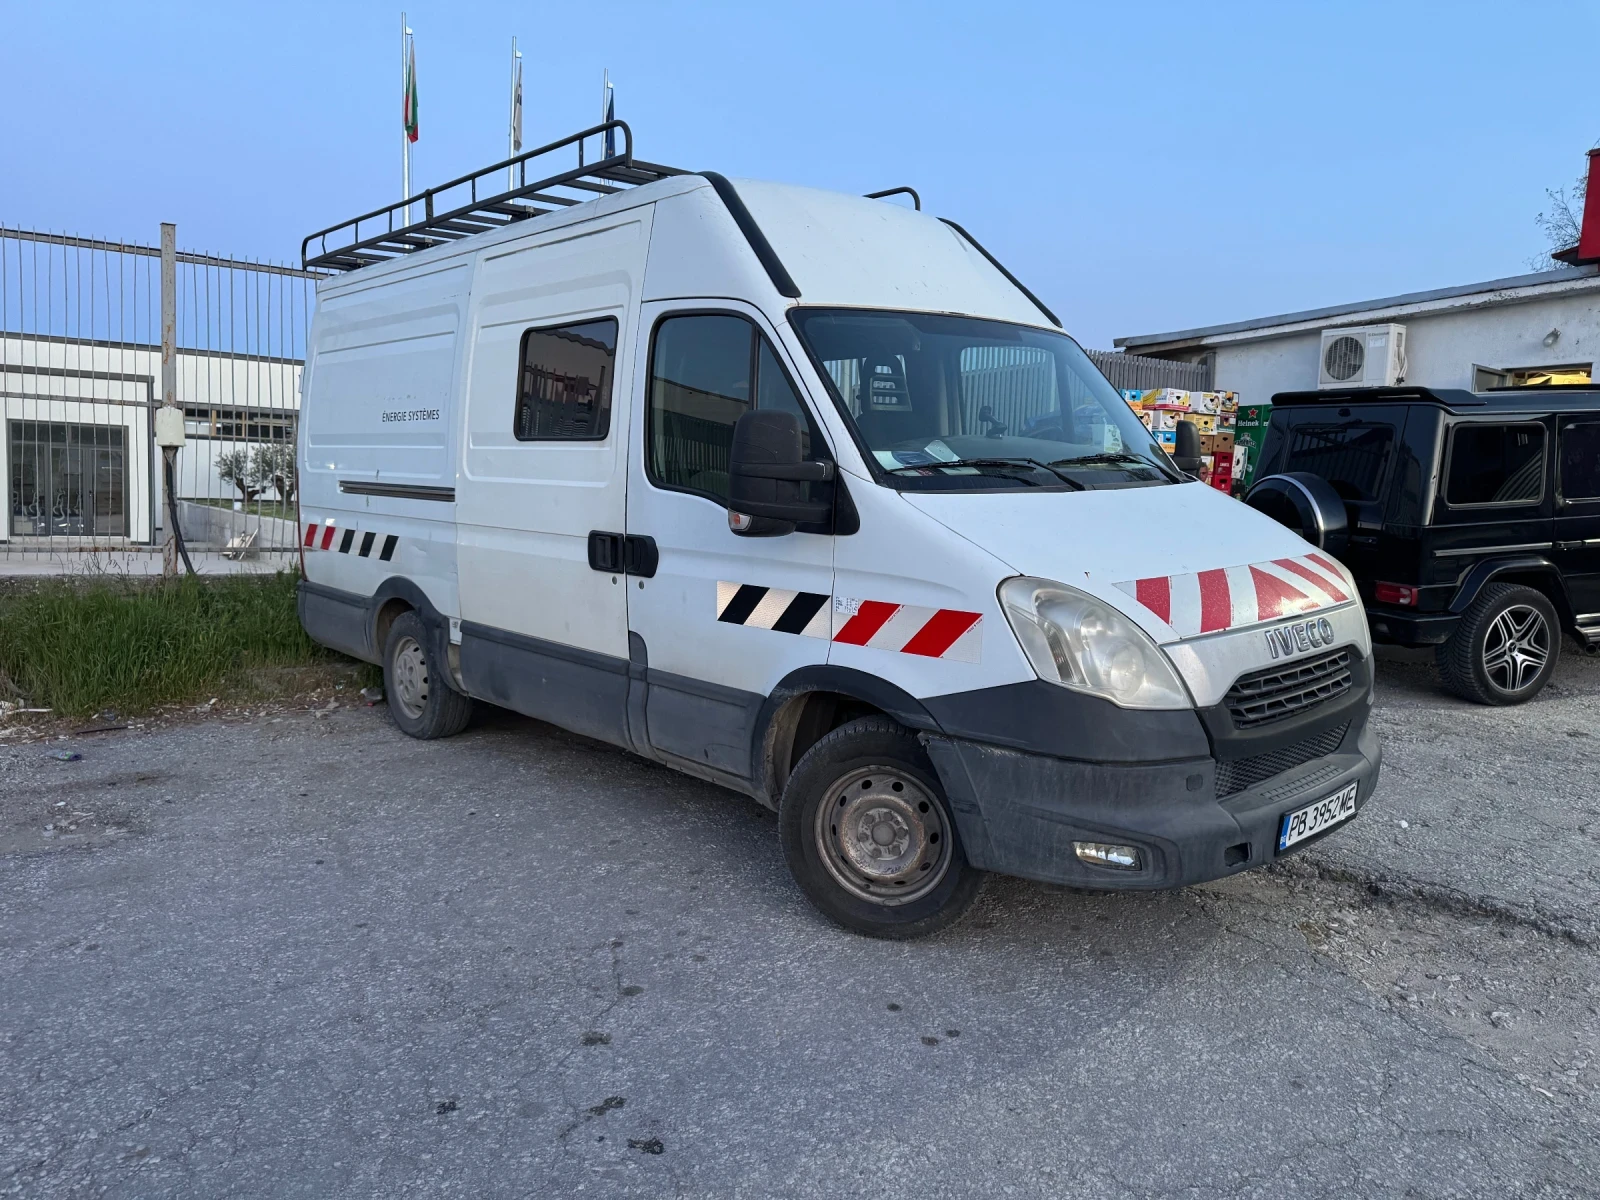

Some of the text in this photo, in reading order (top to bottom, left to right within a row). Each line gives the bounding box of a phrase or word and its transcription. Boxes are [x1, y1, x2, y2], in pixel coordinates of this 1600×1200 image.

[382, 408, 440, 422] ÉNERGIE SYSTÈMES
[1264, 617, 1335, 659] IVECO
[1288, 786, 1356, 841] PB 3952 ME
